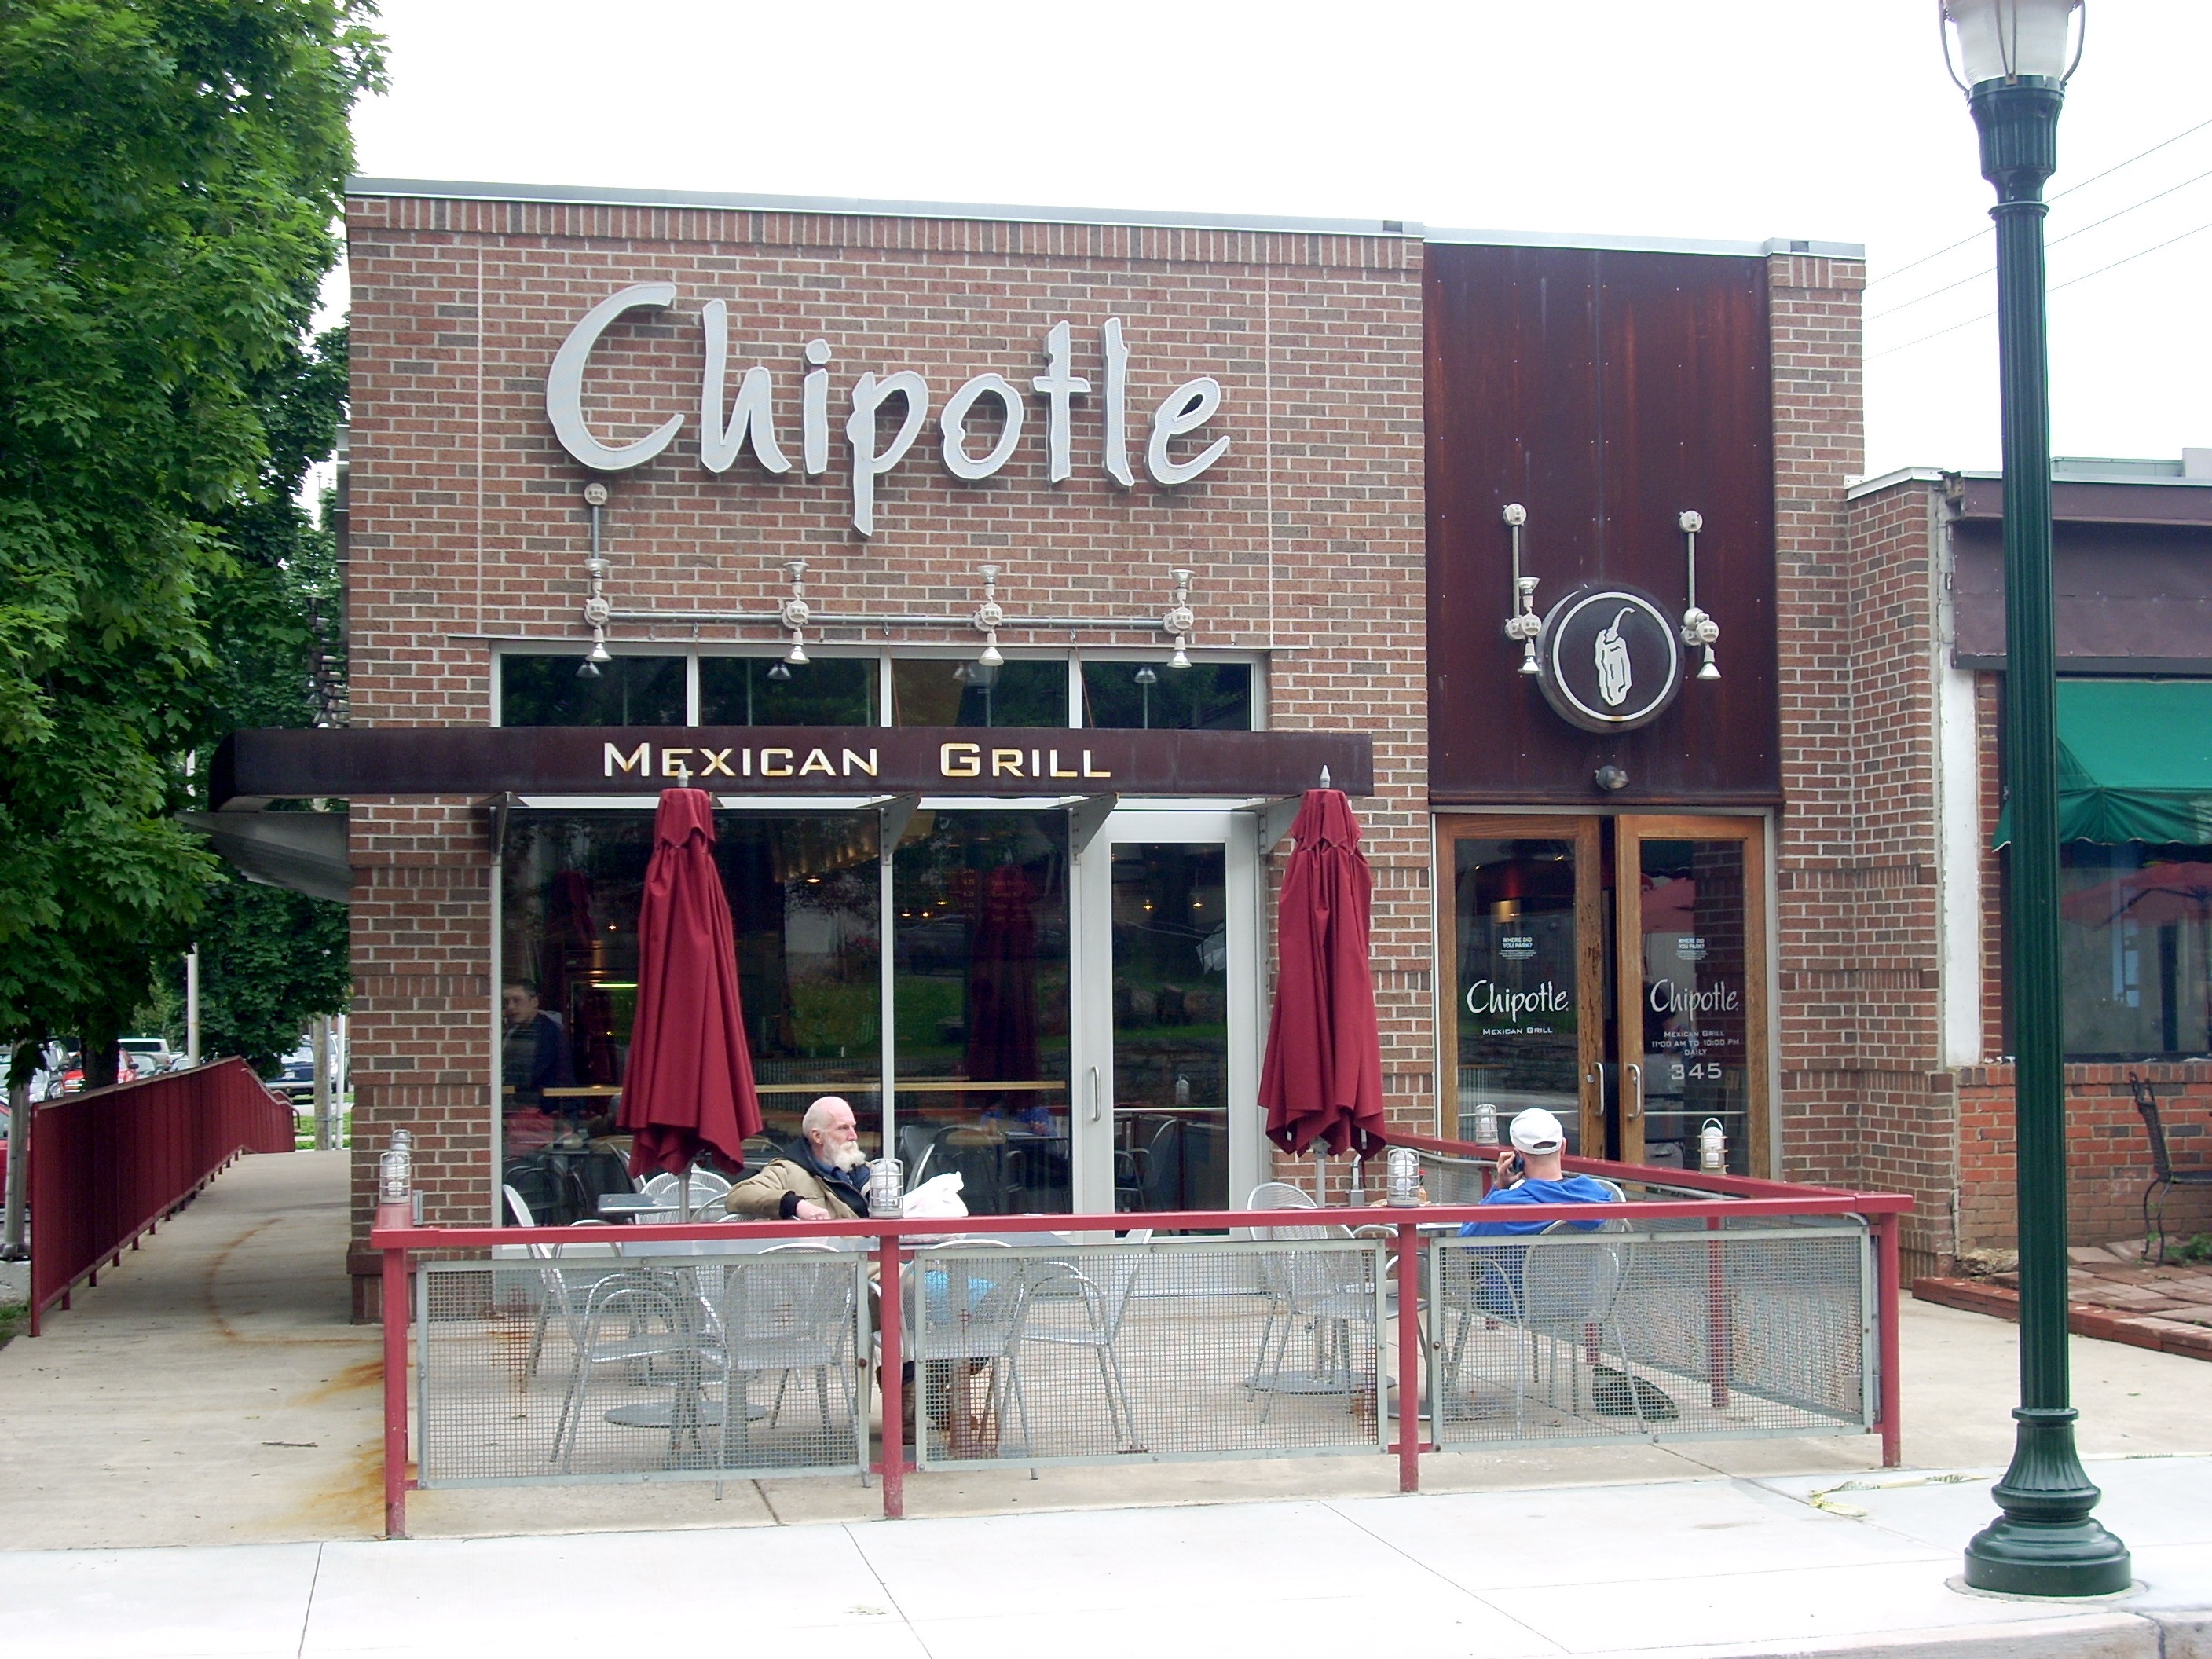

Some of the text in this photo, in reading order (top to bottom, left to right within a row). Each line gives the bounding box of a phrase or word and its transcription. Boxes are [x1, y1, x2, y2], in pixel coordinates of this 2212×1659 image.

[544, 280, 1231, 538] Chipotle
[602, 742, 1114, 780] MEXICAN GRILL
[1467, 980, 1569, 1023] Chipotle
[1650, 979, 1738, 1021] Chipotle
[1671, 1063, 1722, 1080] 345
